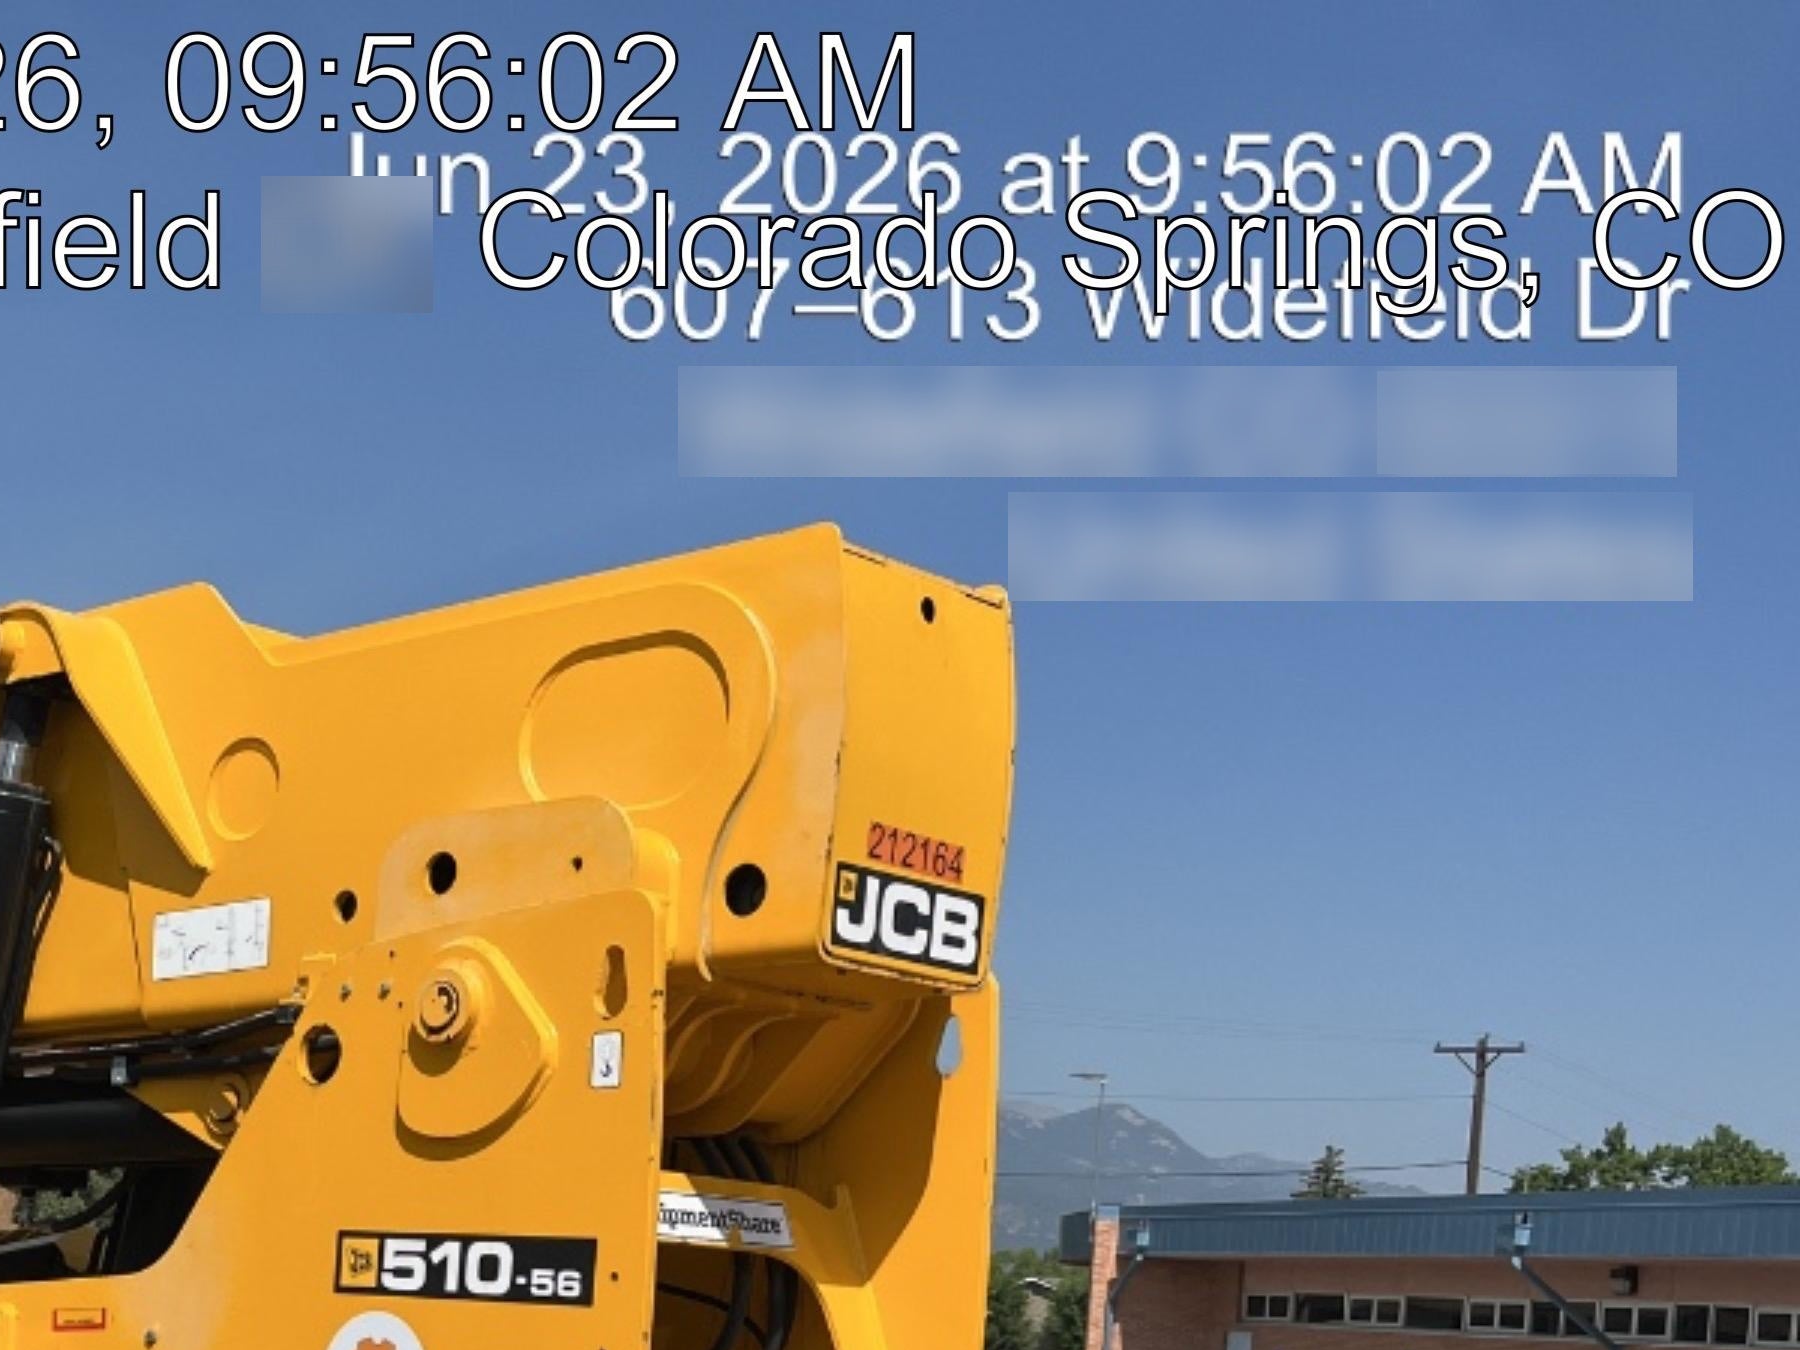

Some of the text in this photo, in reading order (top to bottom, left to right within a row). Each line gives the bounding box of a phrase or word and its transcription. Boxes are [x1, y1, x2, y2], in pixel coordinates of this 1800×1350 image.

[868, 822, 964, 881] 212164
[836, 875, 979, 966] JCB
[380, 1238, 582, 1298] 510-56
